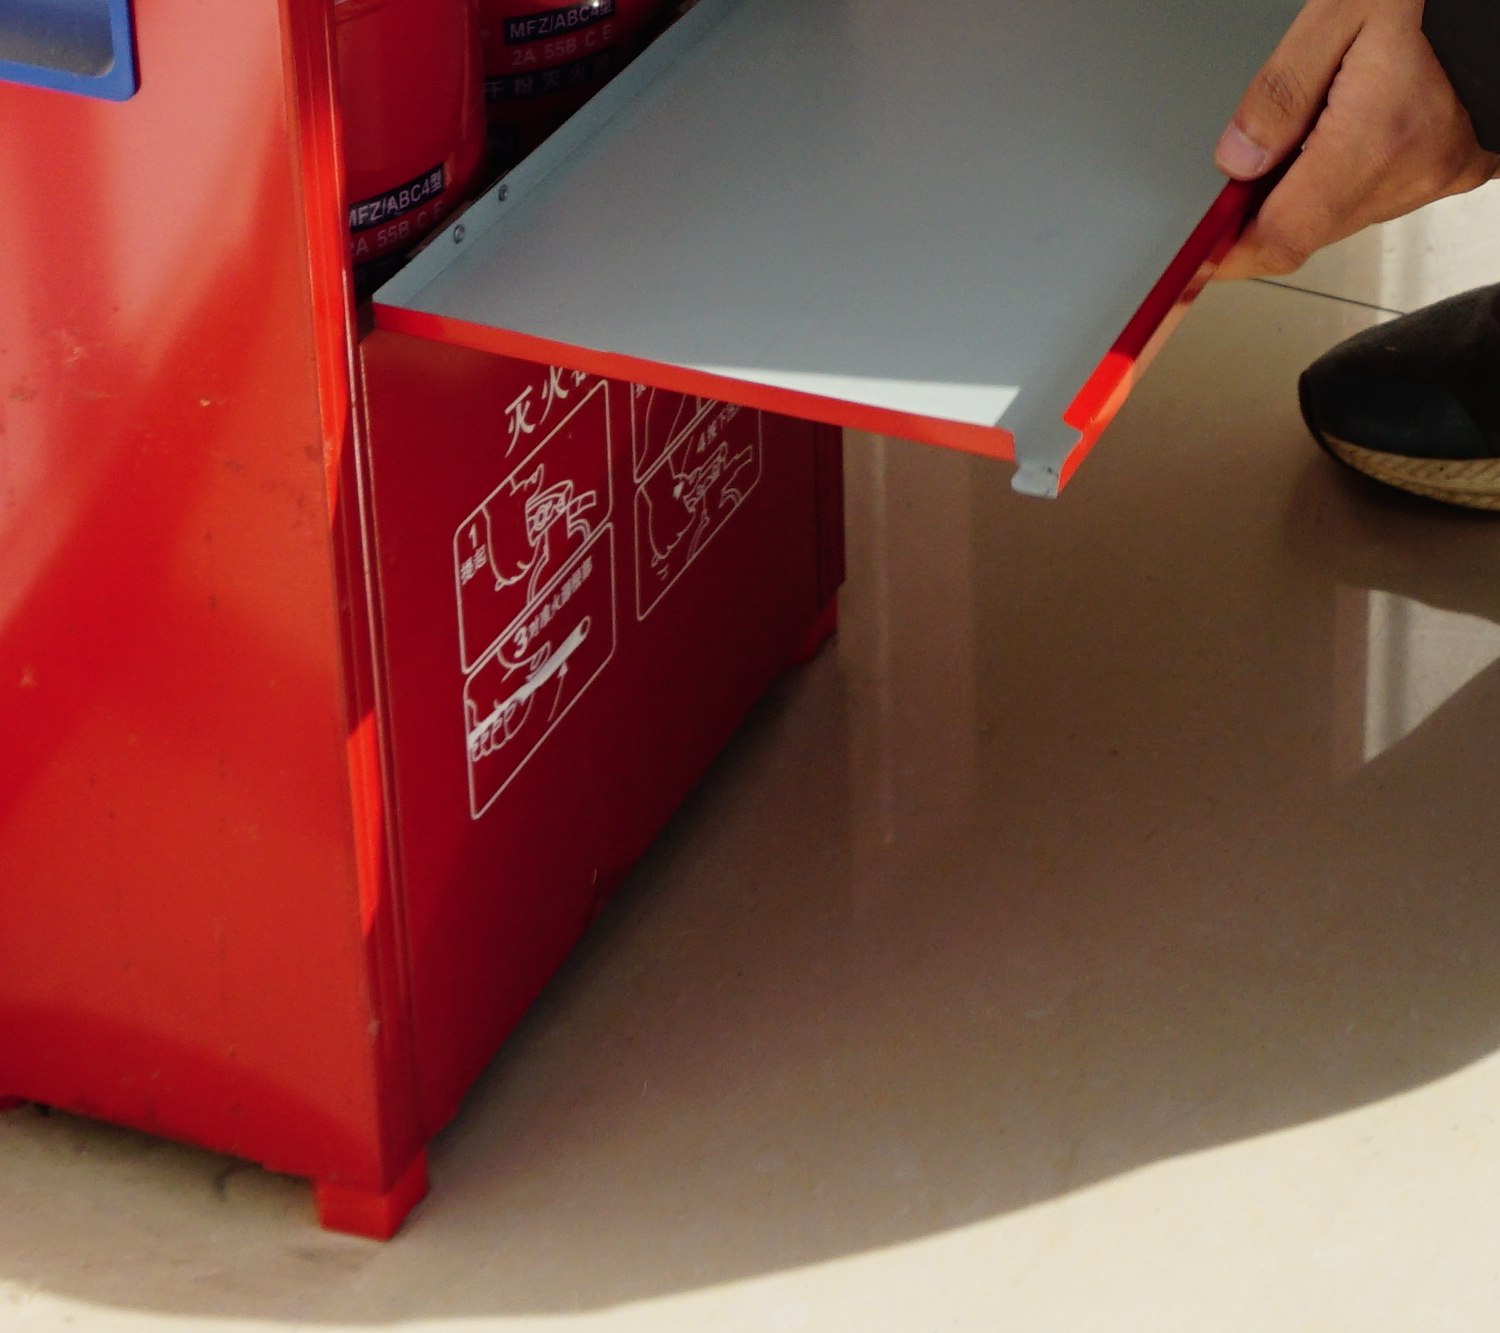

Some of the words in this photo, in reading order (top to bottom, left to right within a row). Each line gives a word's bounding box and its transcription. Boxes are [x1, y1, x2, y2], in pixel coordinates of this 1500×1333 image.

[511, 46, 537, 66] 2A
[543, 36, 578, 59] 55B
[584, 30, 596, 47] C
